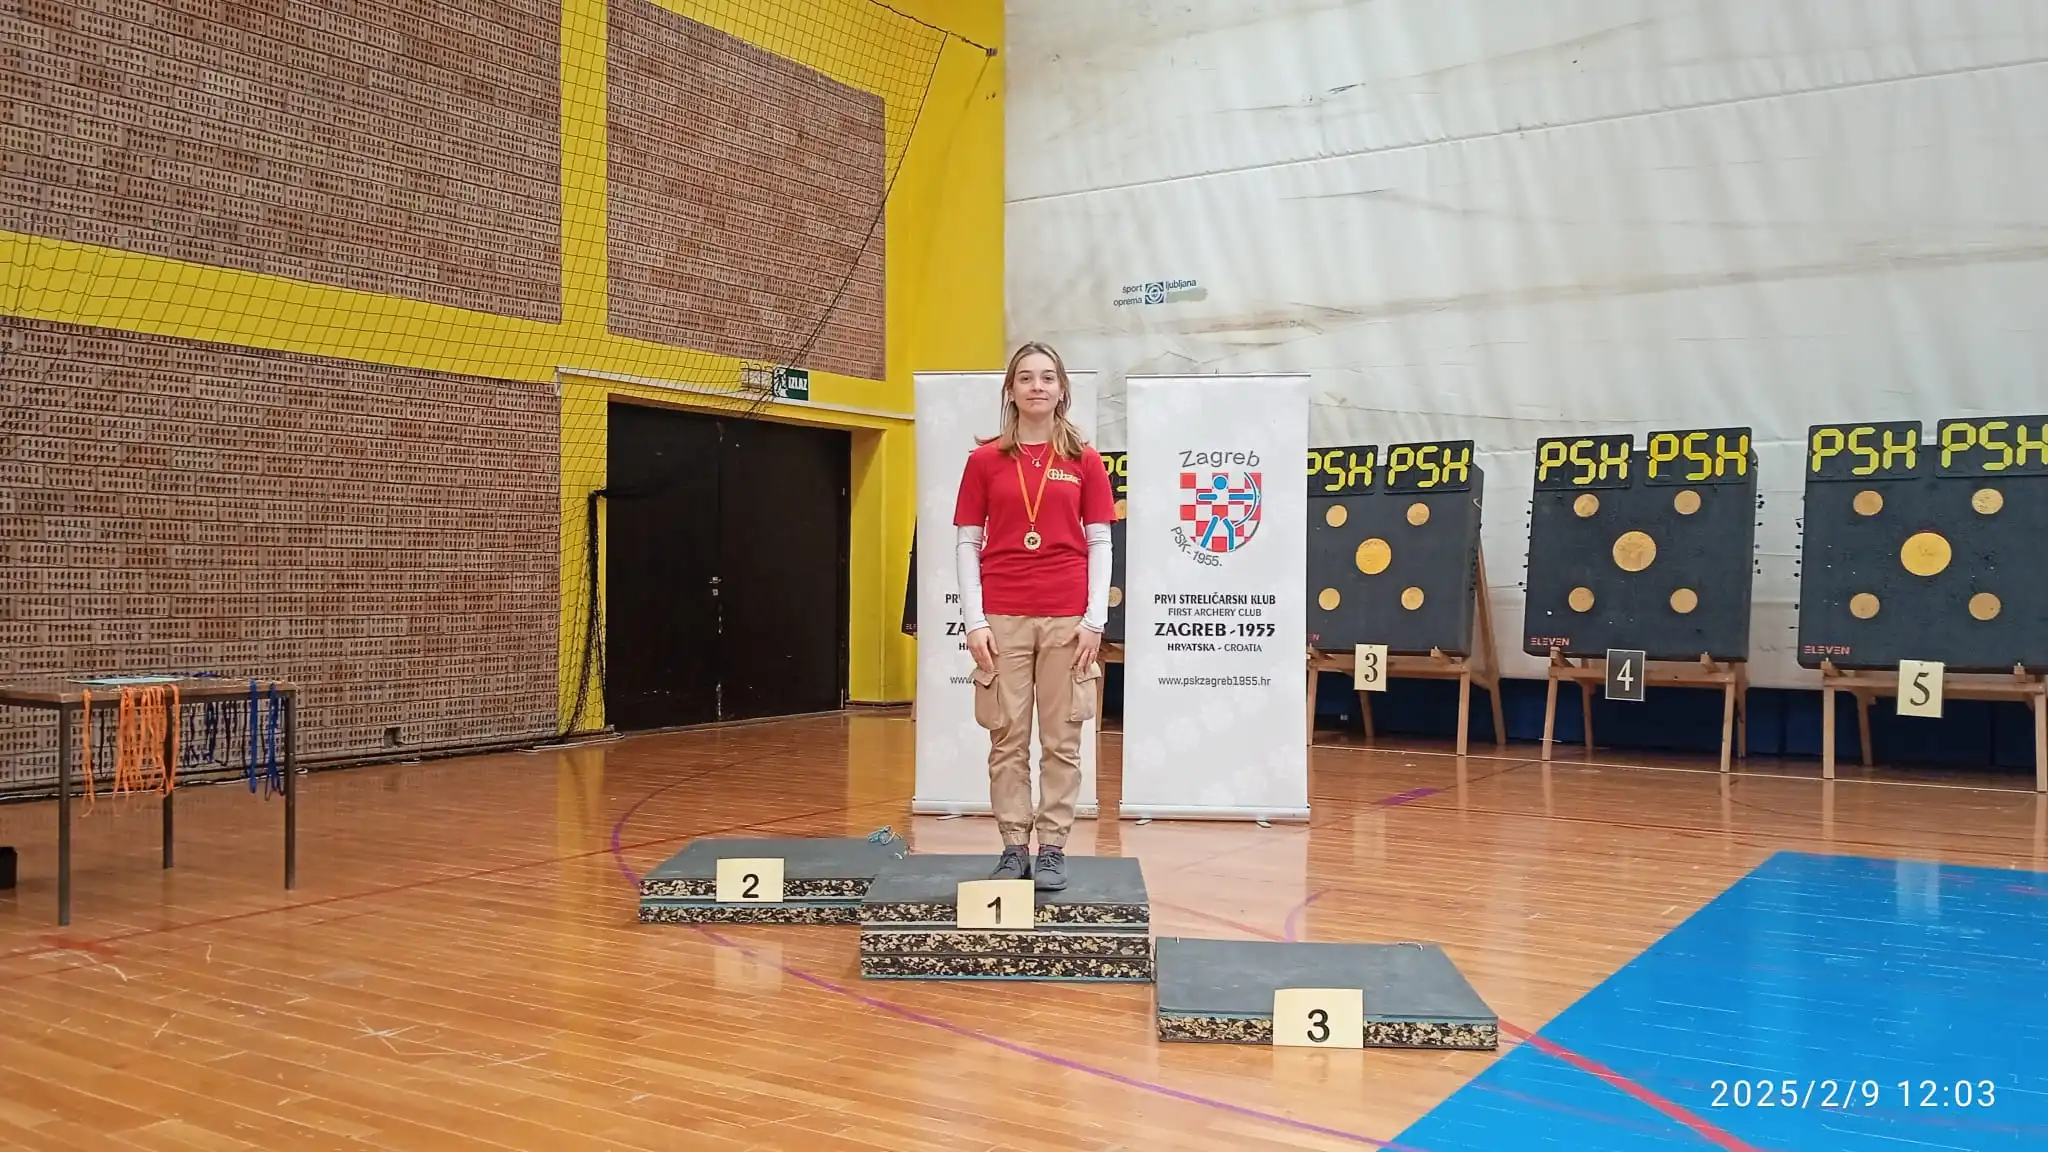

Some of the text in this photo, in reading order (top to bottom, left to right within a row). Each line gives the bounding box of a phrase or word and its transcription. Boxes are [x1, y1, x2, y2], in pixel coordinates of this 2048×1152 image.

[1165, 280, 1196, 290] ljubljana
[1113, 298, 1142, 307] oprema
[788, 376, 808, 391] IZLAZ
[1648, 432, 1749, 481] PSH
[1811, 427, 1917, 475] PSH
[1941, 421, 2048, 471] PSH
[1179, 450, 1260, 468] Zagreb
[1387, 445, 1470, 488] PSH
[1538, 440, 1629, 485] PSH
[1154, 592, 1276, 605] PRVI STRELIČARSKI KLUB
[1168, 608, 1262, 617] FIRST ARCHERY CLUB
[1154, 622, 1227, 637] ZAGREB
[1167, 643, 1215, 652] HRVATSKA
[1224, 643, 1262, 652] CROATIA
[1530, 637, 1570, 646] ELEVEN
[1804, 645, 1851, 655] ELEVEN
[1364, 652, 1378, 683] 3
[1616, 658, 1634, 692] 4
[1158, 676, 1271, 687] www.pskzagreb1955.hr
[1909, 672, 1931, 706] 5
[742, 873, 760, 899] 2
[987, 896, 1002, 924] 1
[1306, 1009, 1331, 1043] 3
